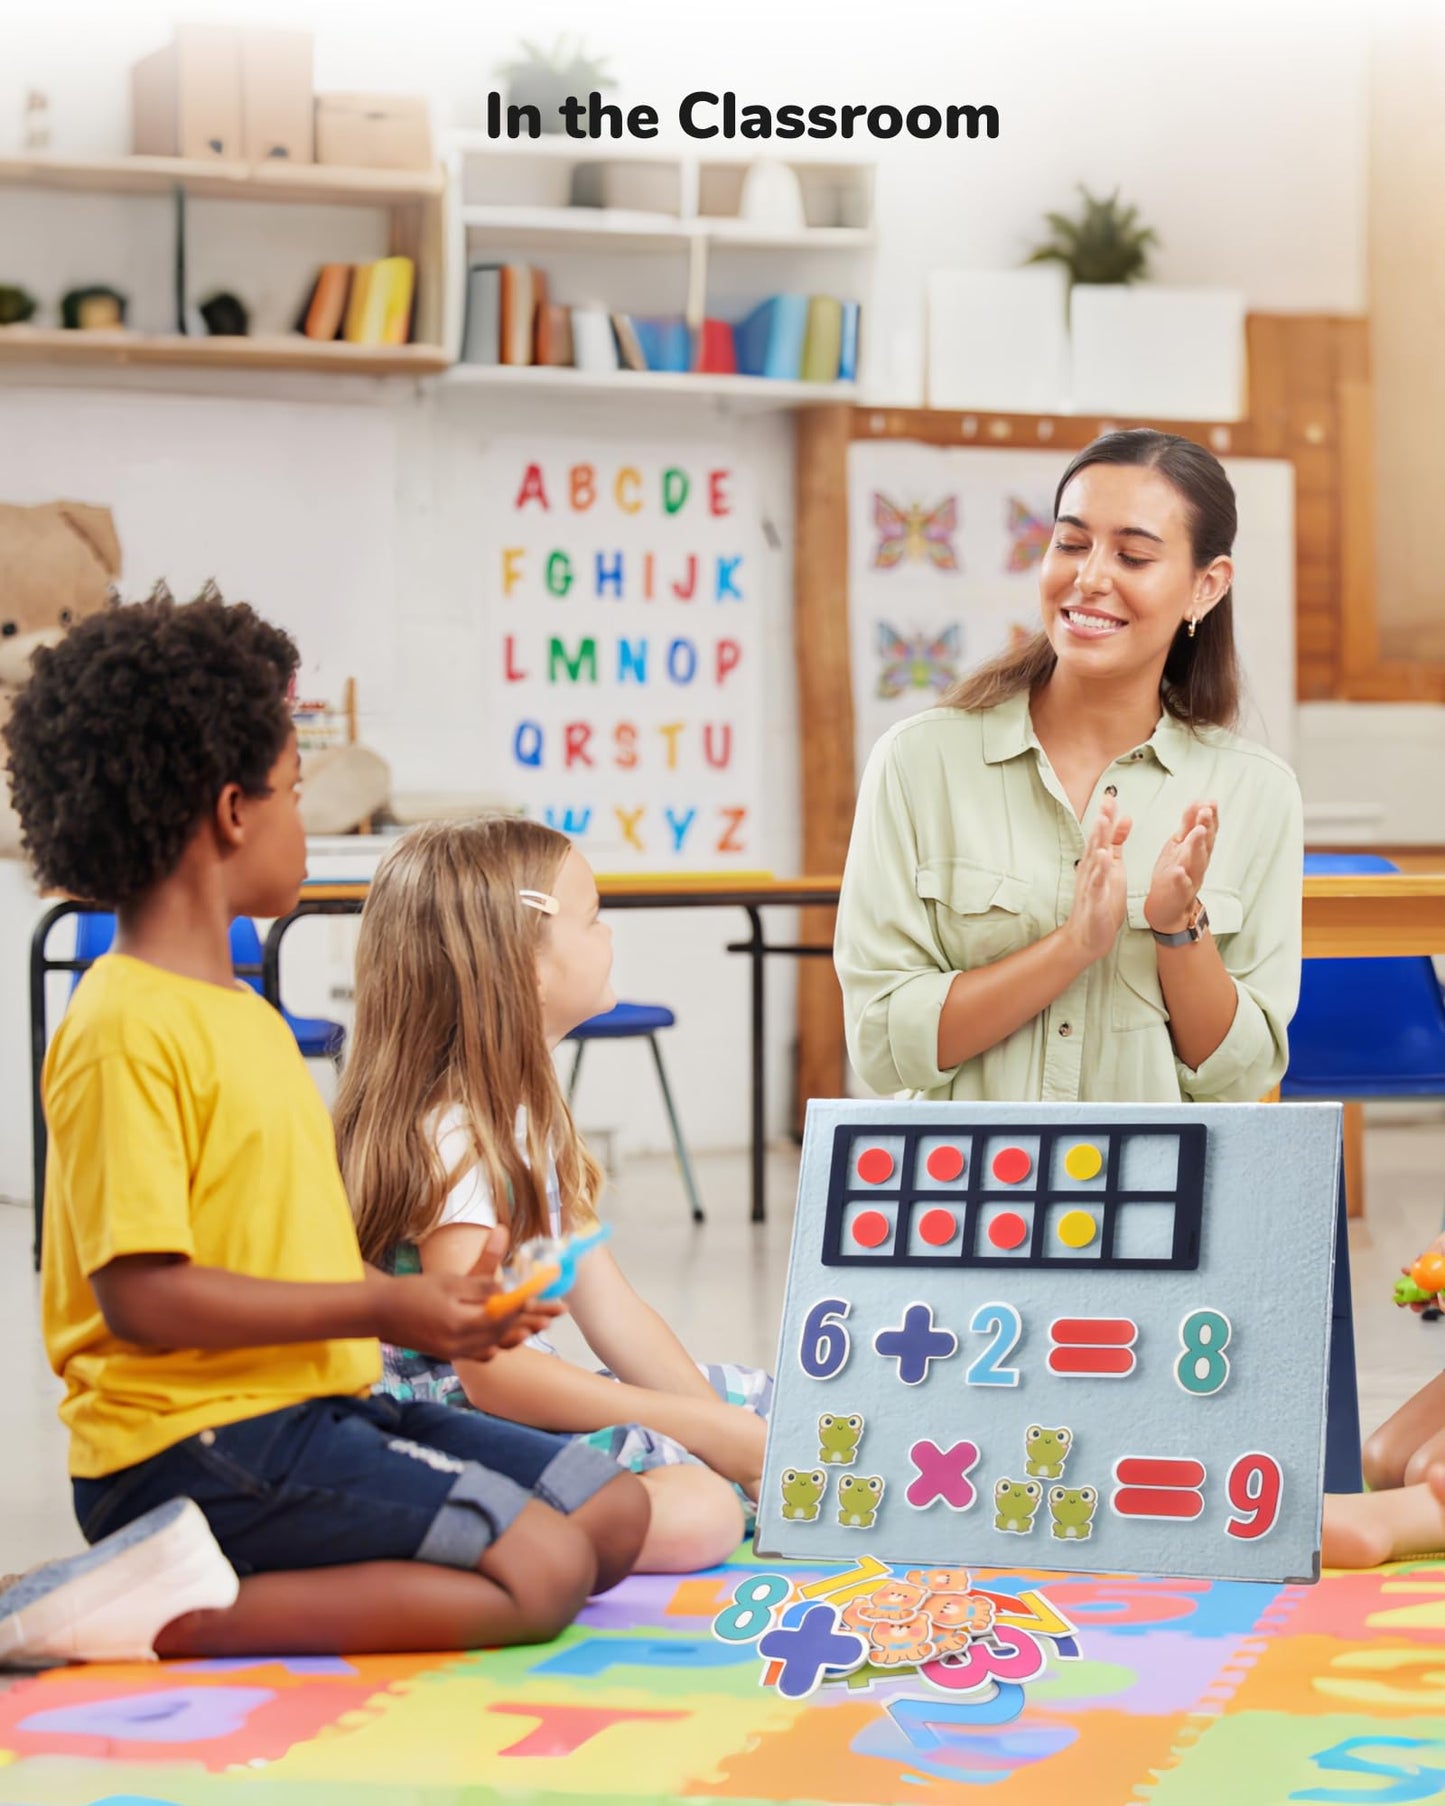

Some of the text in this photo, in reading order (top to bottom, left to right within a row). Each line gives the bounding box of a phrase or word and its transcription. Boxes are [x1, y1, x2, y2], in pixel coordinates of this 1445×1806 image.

[515, 462, 730, 517] A B C D E
[502, 548, 743, 602] F G H I J K
[504, 635, 742, 686] L M N O P
[513, 720, 732, 771] Q R S T U
[615, 806, 645, 852] X
[665, 807, 696, 853] Y
[716, 806, 748, 853] Z
[801, 1300, 850, 1378] 6
[967, 1304, 1021, 1386] 2
[1175, 1309, 1230, 1393] 8
[1226, 1453, 1281, 1539] 9
[713, 1574, 791, 1643] 8
